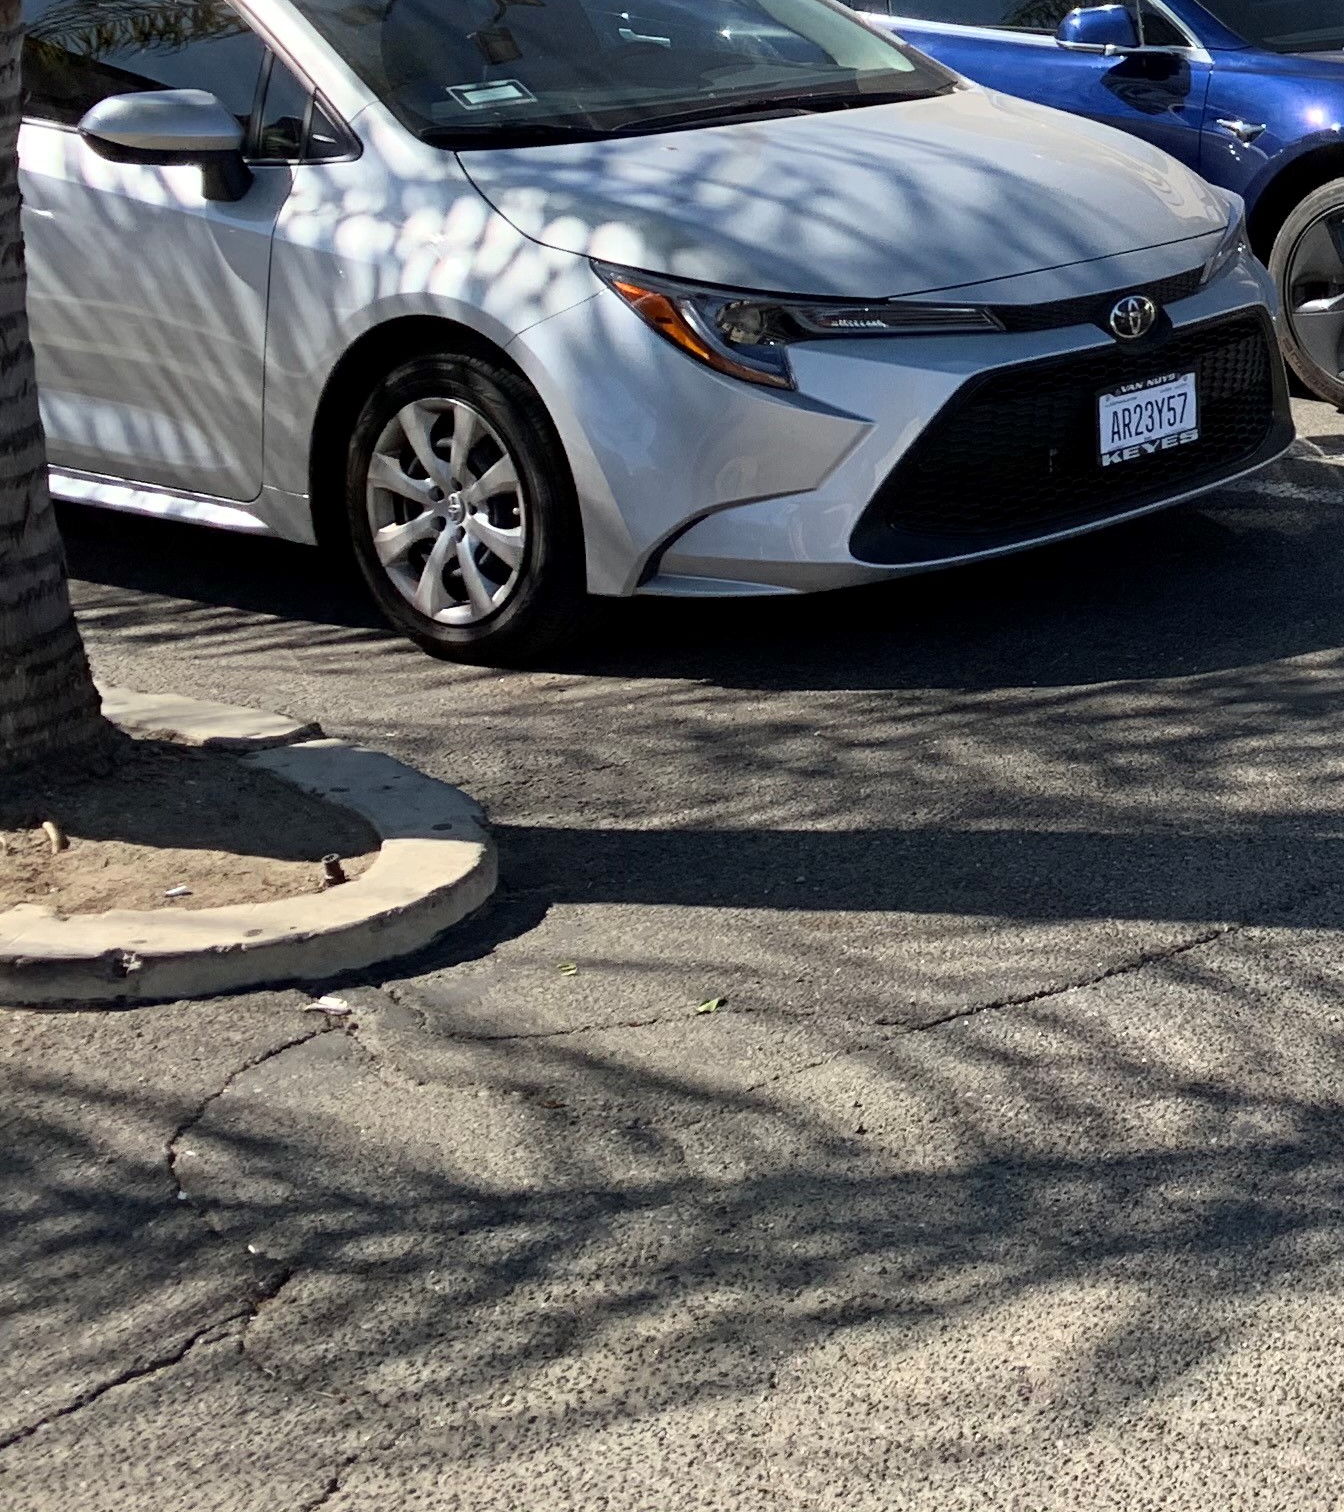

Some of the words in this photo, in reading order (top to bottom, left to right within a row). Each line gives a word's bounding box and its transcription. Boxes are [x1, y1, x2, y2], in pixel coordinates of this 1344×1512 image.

[1121, 382, 1144, 393] VAN
[1146, 373, 1176, 387] NUYS
[1112, 392, 1188, 444] AR23Y57
[1102, 429, 1199, 467] KEYES
